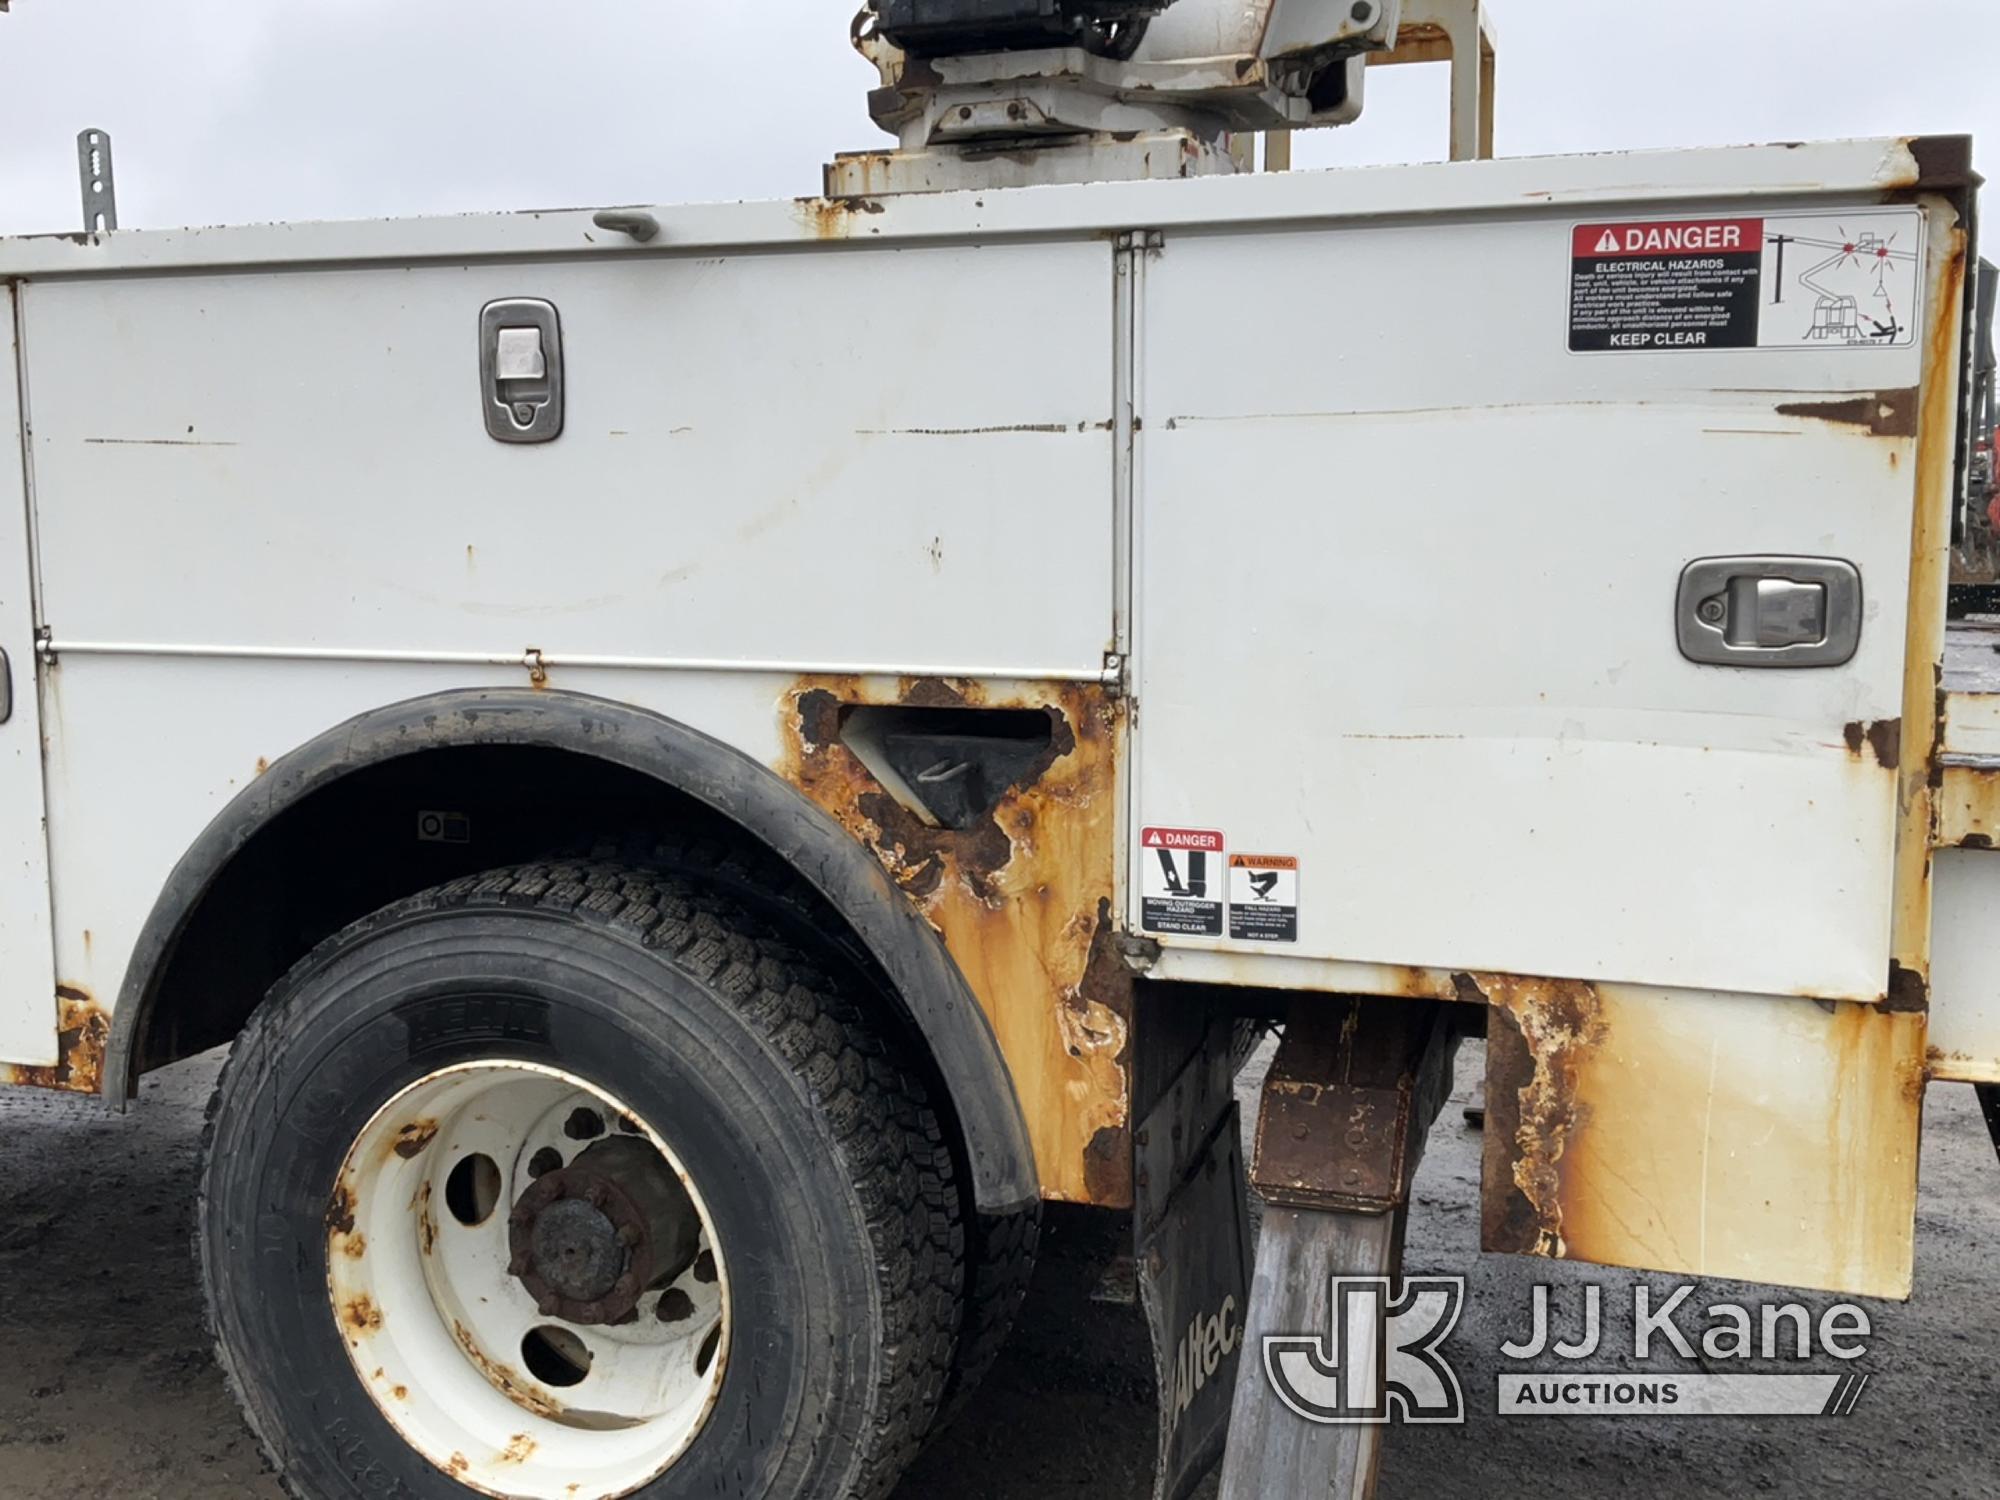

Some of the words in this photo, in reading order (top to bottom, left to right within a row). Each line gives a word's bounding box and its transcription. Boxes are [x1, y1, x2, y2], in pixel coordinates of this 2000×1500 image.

[1625, 225, 1740, 251] DANGER
[1596, 262, 1665, 272] ELECTRICAL
[1669, 259, 1724, 270] HAZARDS
[1610, 334, 1652, 346] KEEP
[1654, 332, 1707, 345] CLEAR
[1165, 833, 1217, 847] DANGER
[1247, 858, 1294, 868] WARNING
[1157, 922, 1180, 930] STAND
[1182, 923, 1207, 931] CLEAR
